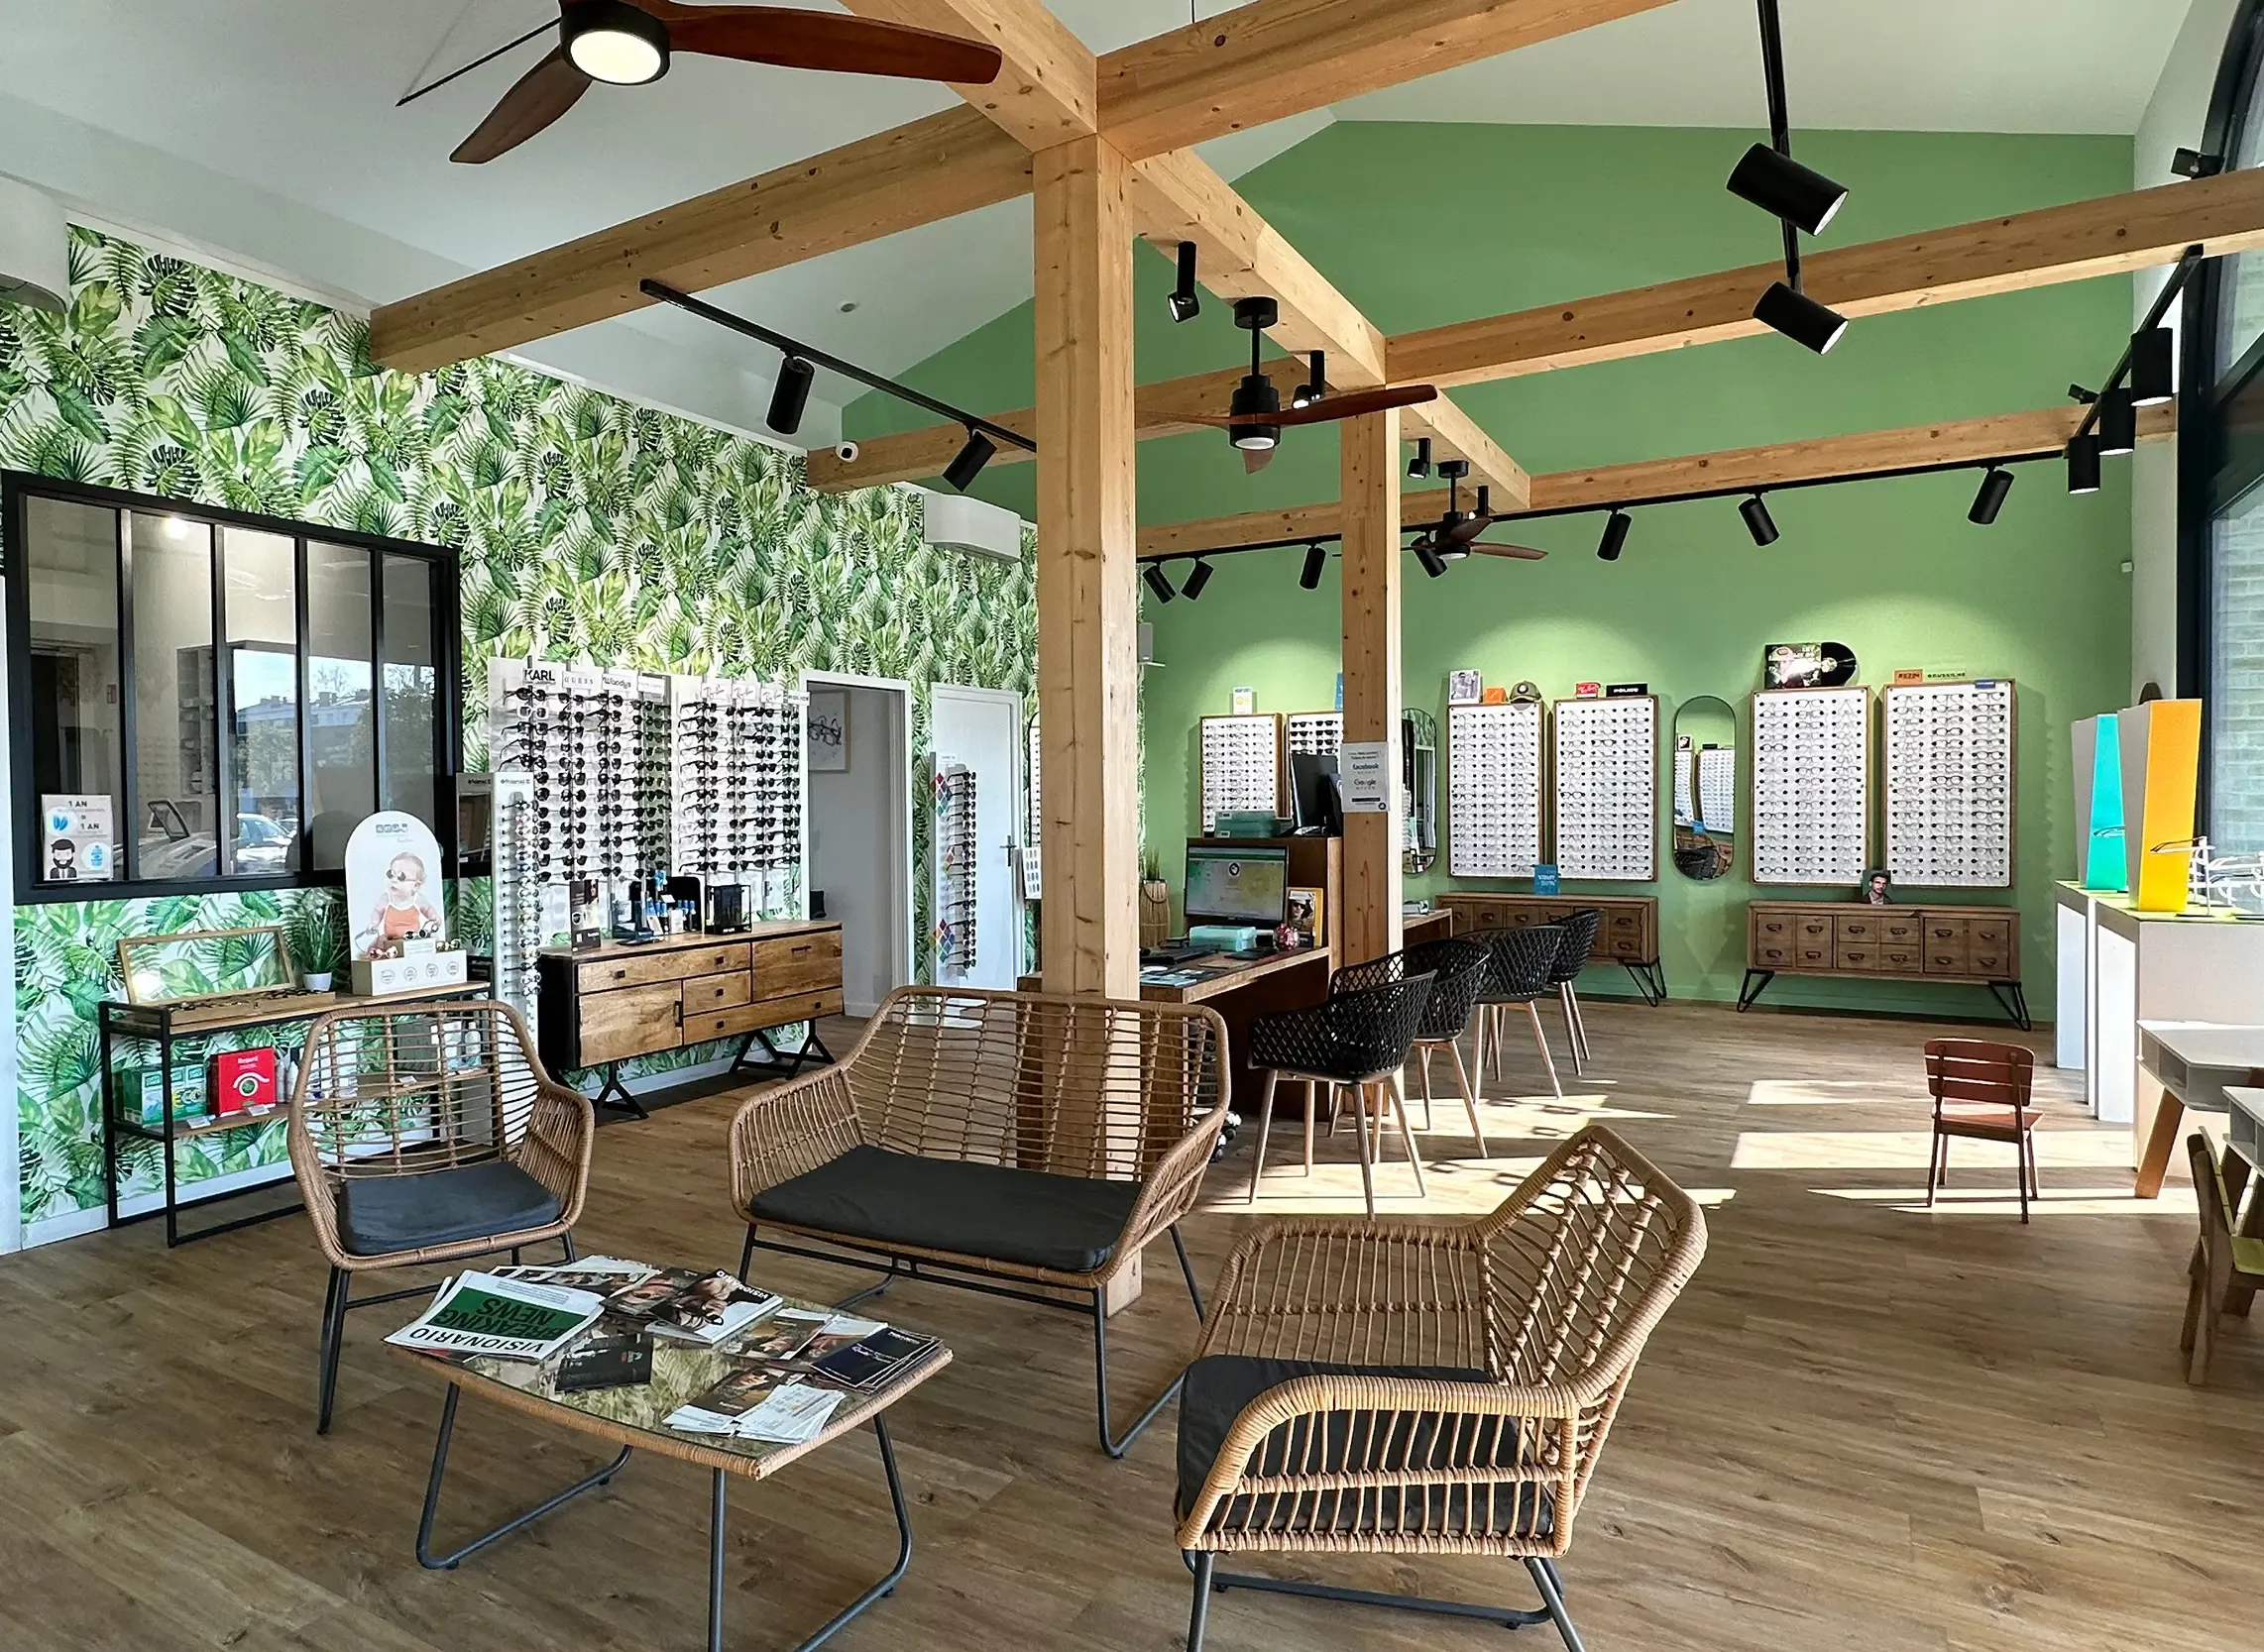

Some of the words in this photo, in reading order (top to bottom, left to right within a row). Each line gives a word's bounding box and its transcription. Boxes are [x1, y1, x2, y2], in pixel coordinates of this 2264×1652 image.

[524, 669, 555, 681] KARL
[433, 1308, 566, 1339] BREAKING
[476, 1297, 557, 1325] NEWS
[409, 1327, 544, 1353] VISIONARIO
